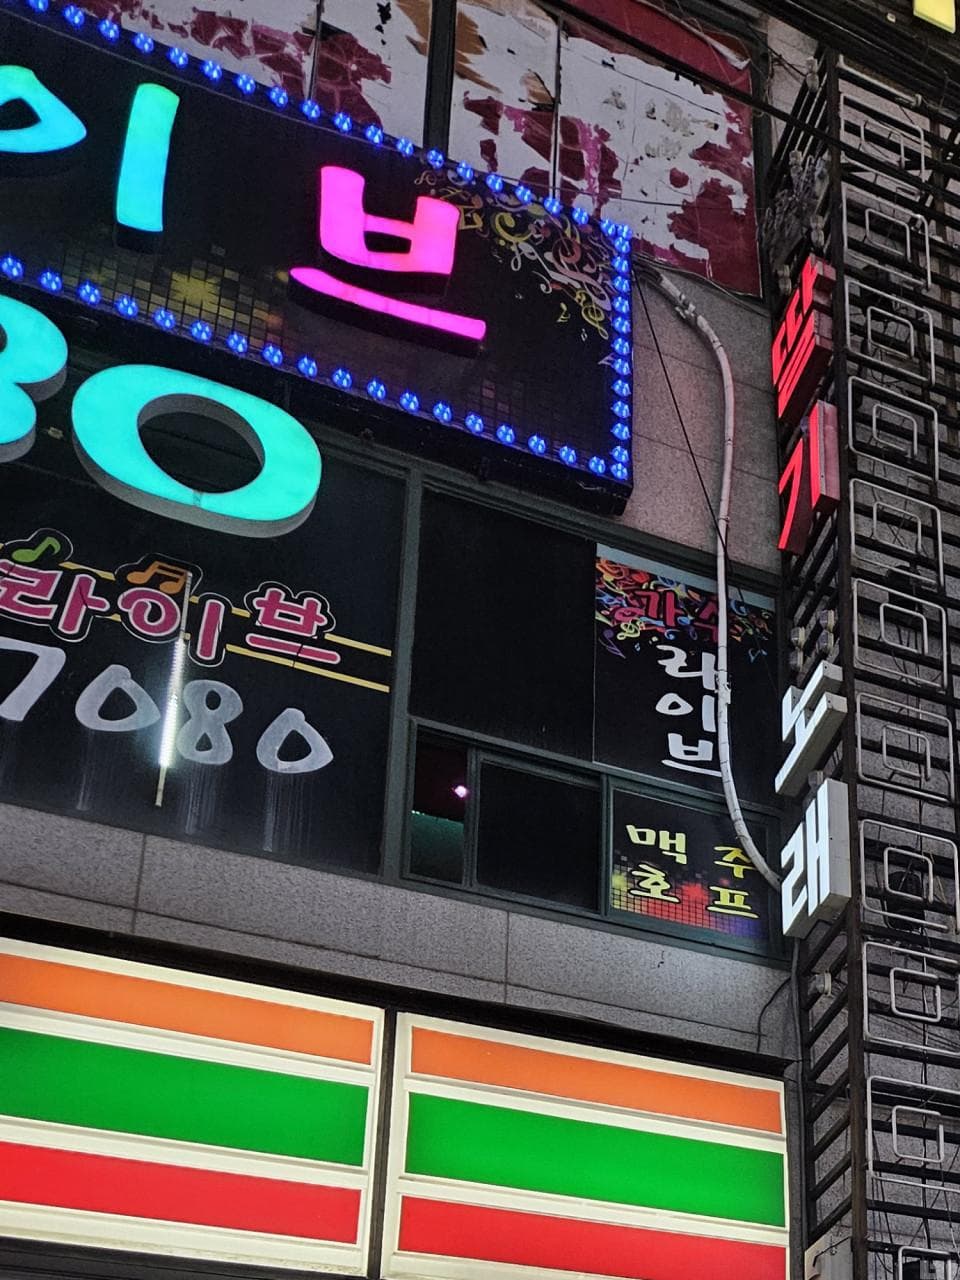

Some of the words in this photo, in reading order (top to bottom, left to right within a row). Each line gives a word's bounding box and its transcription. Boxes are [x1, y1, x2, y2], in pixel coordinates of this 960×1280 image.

[771, 253, 832, 552] 딸기
[0, 558, 342, 665] 라이브
[0, 636, 335, 774] 7080
[655, 644, 723, 778] 라이브
[625, 824, 758, 879] 맥주
[774, 661, 842, 938] 노래
